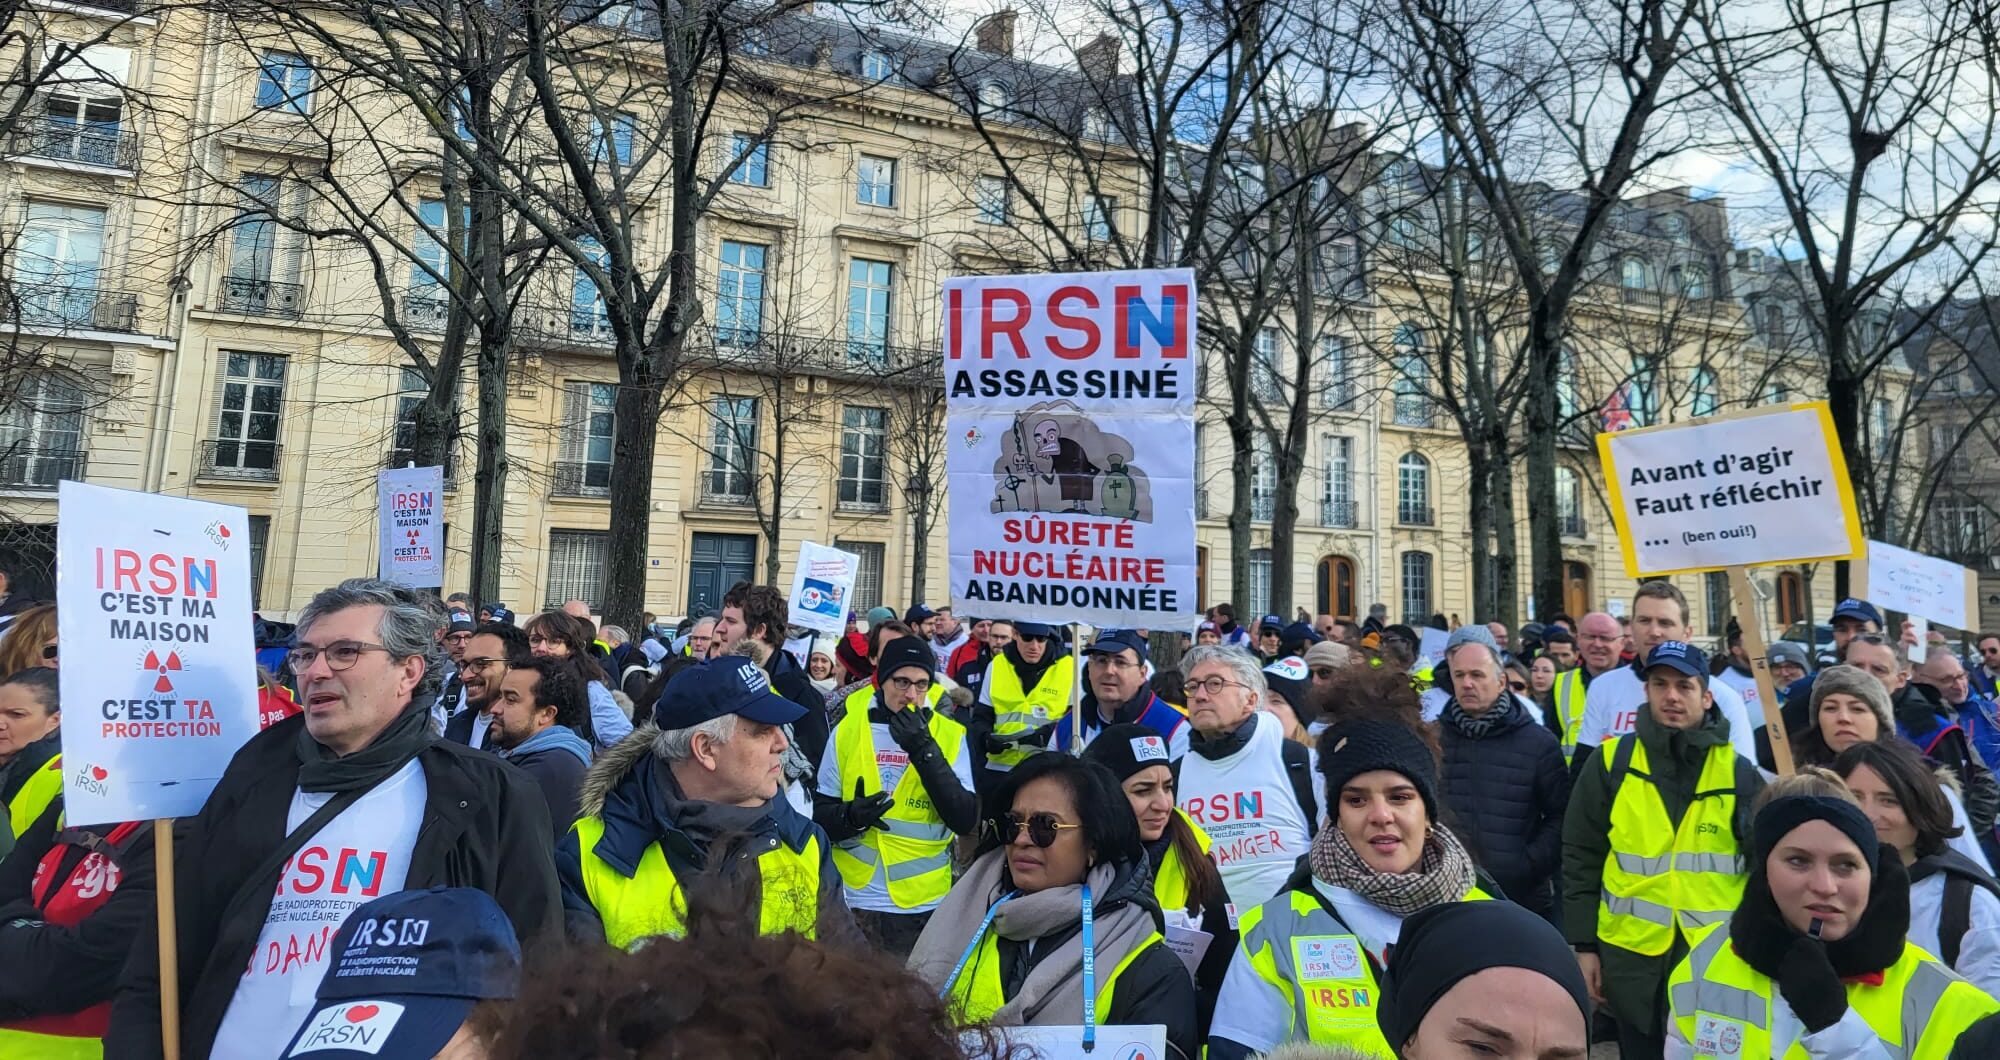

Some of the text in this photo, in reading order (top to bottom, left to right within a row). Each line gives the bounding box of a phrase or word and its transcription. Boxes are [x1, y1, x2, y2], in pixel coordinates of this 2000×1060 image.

[949, 285, 1188, 360] IRSN
[951, 363, 1178, 399] ASSASSINÉ
[1630, 463, 1706, 486] Avant
[392, 492, 432, 510] IRSN
[1635, 476, 1822, 516] Faut réfléchir
[397, 518, 429, 527] MAISON
[419, 508, 432, 516] MA
[203, 525, 229, 551] IRSN
[1003, 515, 1134, 549] SÛRETÉ
[1682, 531, 1716, 546] (ben
[1720, 524, 1757, 541] oui!)
[395, 554, 432, 562] PROTECTION
[420, 547, 430, 555] TA
[96, 547, 218, 599] IRSN
[973, 549, 1165, 584] NUCLÉAIRE
[101, 592, 216, 619] C'EST MA
[965, 579, 1178, 612] ABANDONNÉE
[110, 620, 209, 643] MAISON
[102, 700, 215, 720] C'EST TA
[268, 709, 286, 726] pas
[102, 723, 221, 737] PROTECTION
[1138, 747, 1166, 760] IRSN
[74, 775, 109, 797] IRSN
[905, 798, 930, 810] IRSN
[1207, 822, 1261, 832] RADIOPROTECTION
[289, 910, 341, 922] NUCLÉAIRE
[348, 918, 429, 947] IRSN
[374, 965, 417, 976] NUCLÉAIRE
[1084, 947, 1093, 975] IRSN
[1305, 962, 1330, 970] IRSN
[1311, 988, 1371, 1008] IRSN
[1085, 999, 1095, 1028] IRSN
[303, 1025, 377, 1049] IRSN
